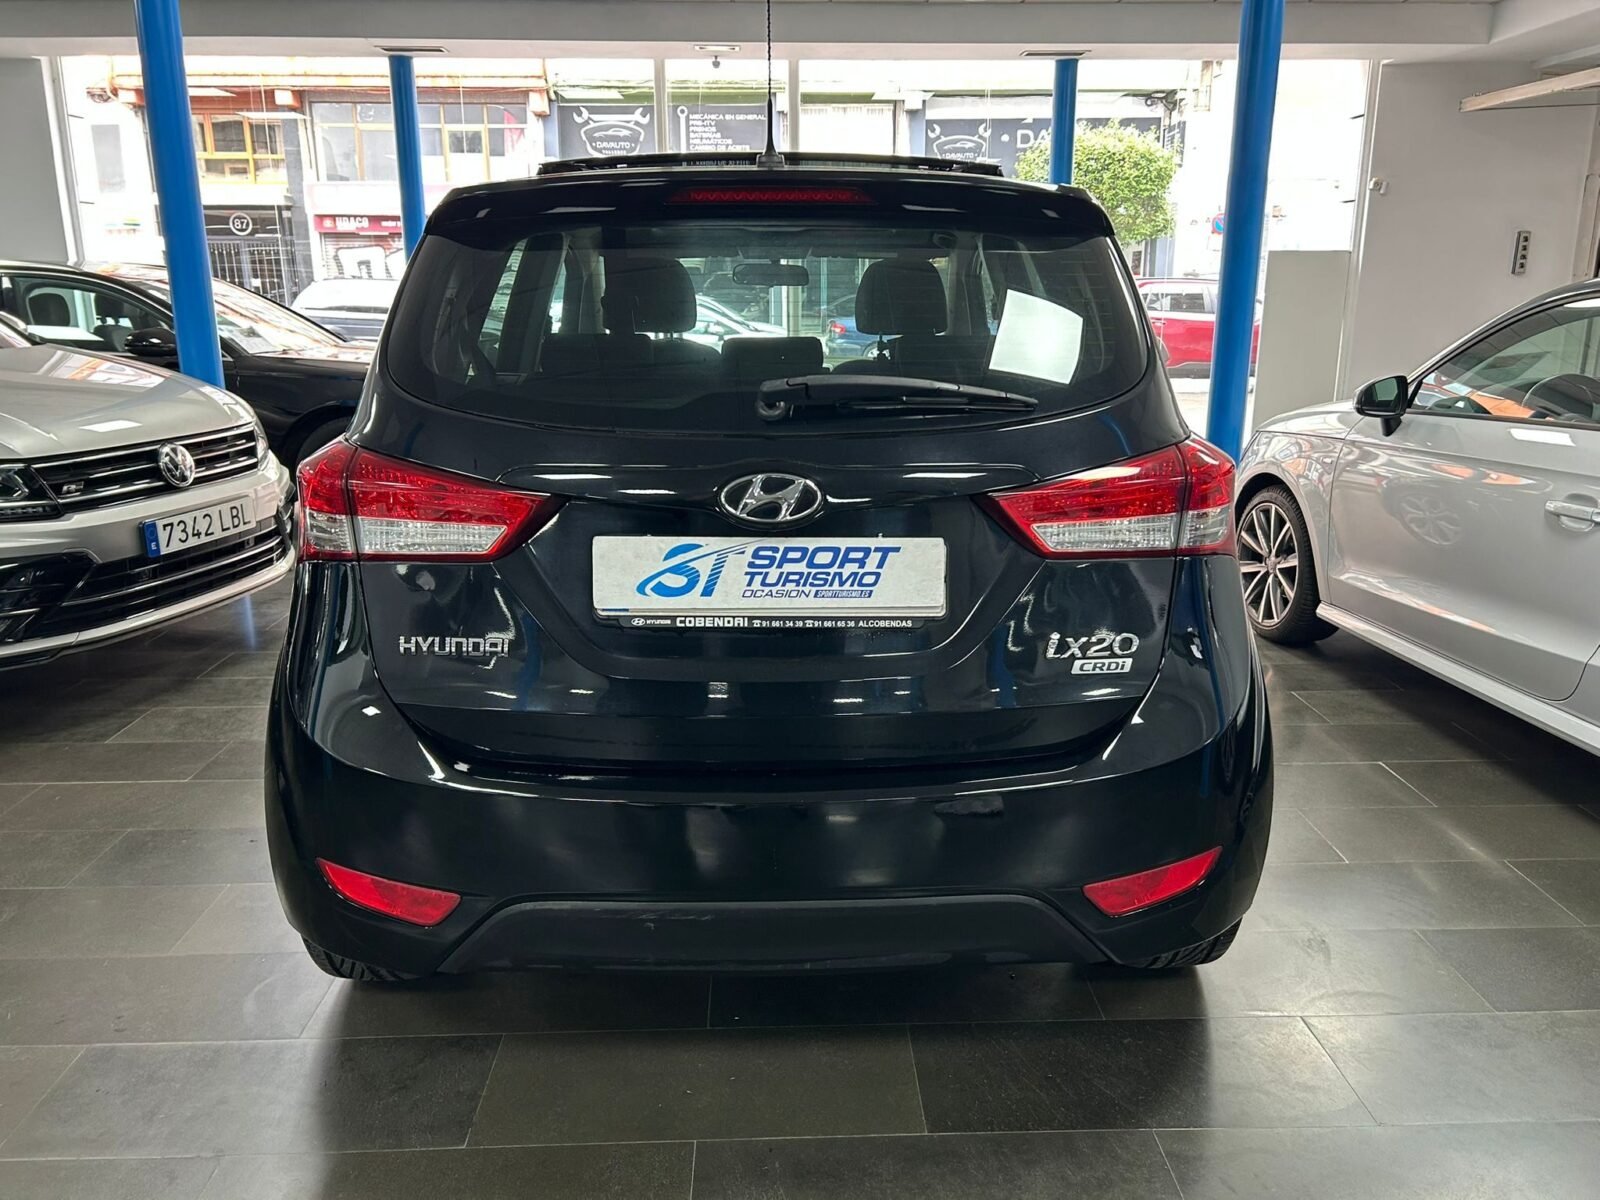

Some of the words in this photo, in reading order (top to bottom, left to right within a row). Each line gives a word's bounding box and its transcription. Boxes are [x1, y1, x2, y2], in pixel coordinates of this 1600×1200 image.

[596, 141, 631, 149] DAVAUTO
[234, 219, 248, 229] 87
[163, 513, 215, 548] 7342
[218, 504, 252, 532] LBL
[747, 546, 902, 569] SPORT
[744, 571, 882, 588] TURISMO
[742, 589, 812, 598] OCASION
[816, 590, 870, 598] SPORTTURISMO.ES
[676, 617, 748, 627] COBENDAI
[858, 620, 912, 628] ALCOBENDAS
[399, 636, 509, 657] HYUNDAI
[1078, 660, 1127, 672] CRDi
